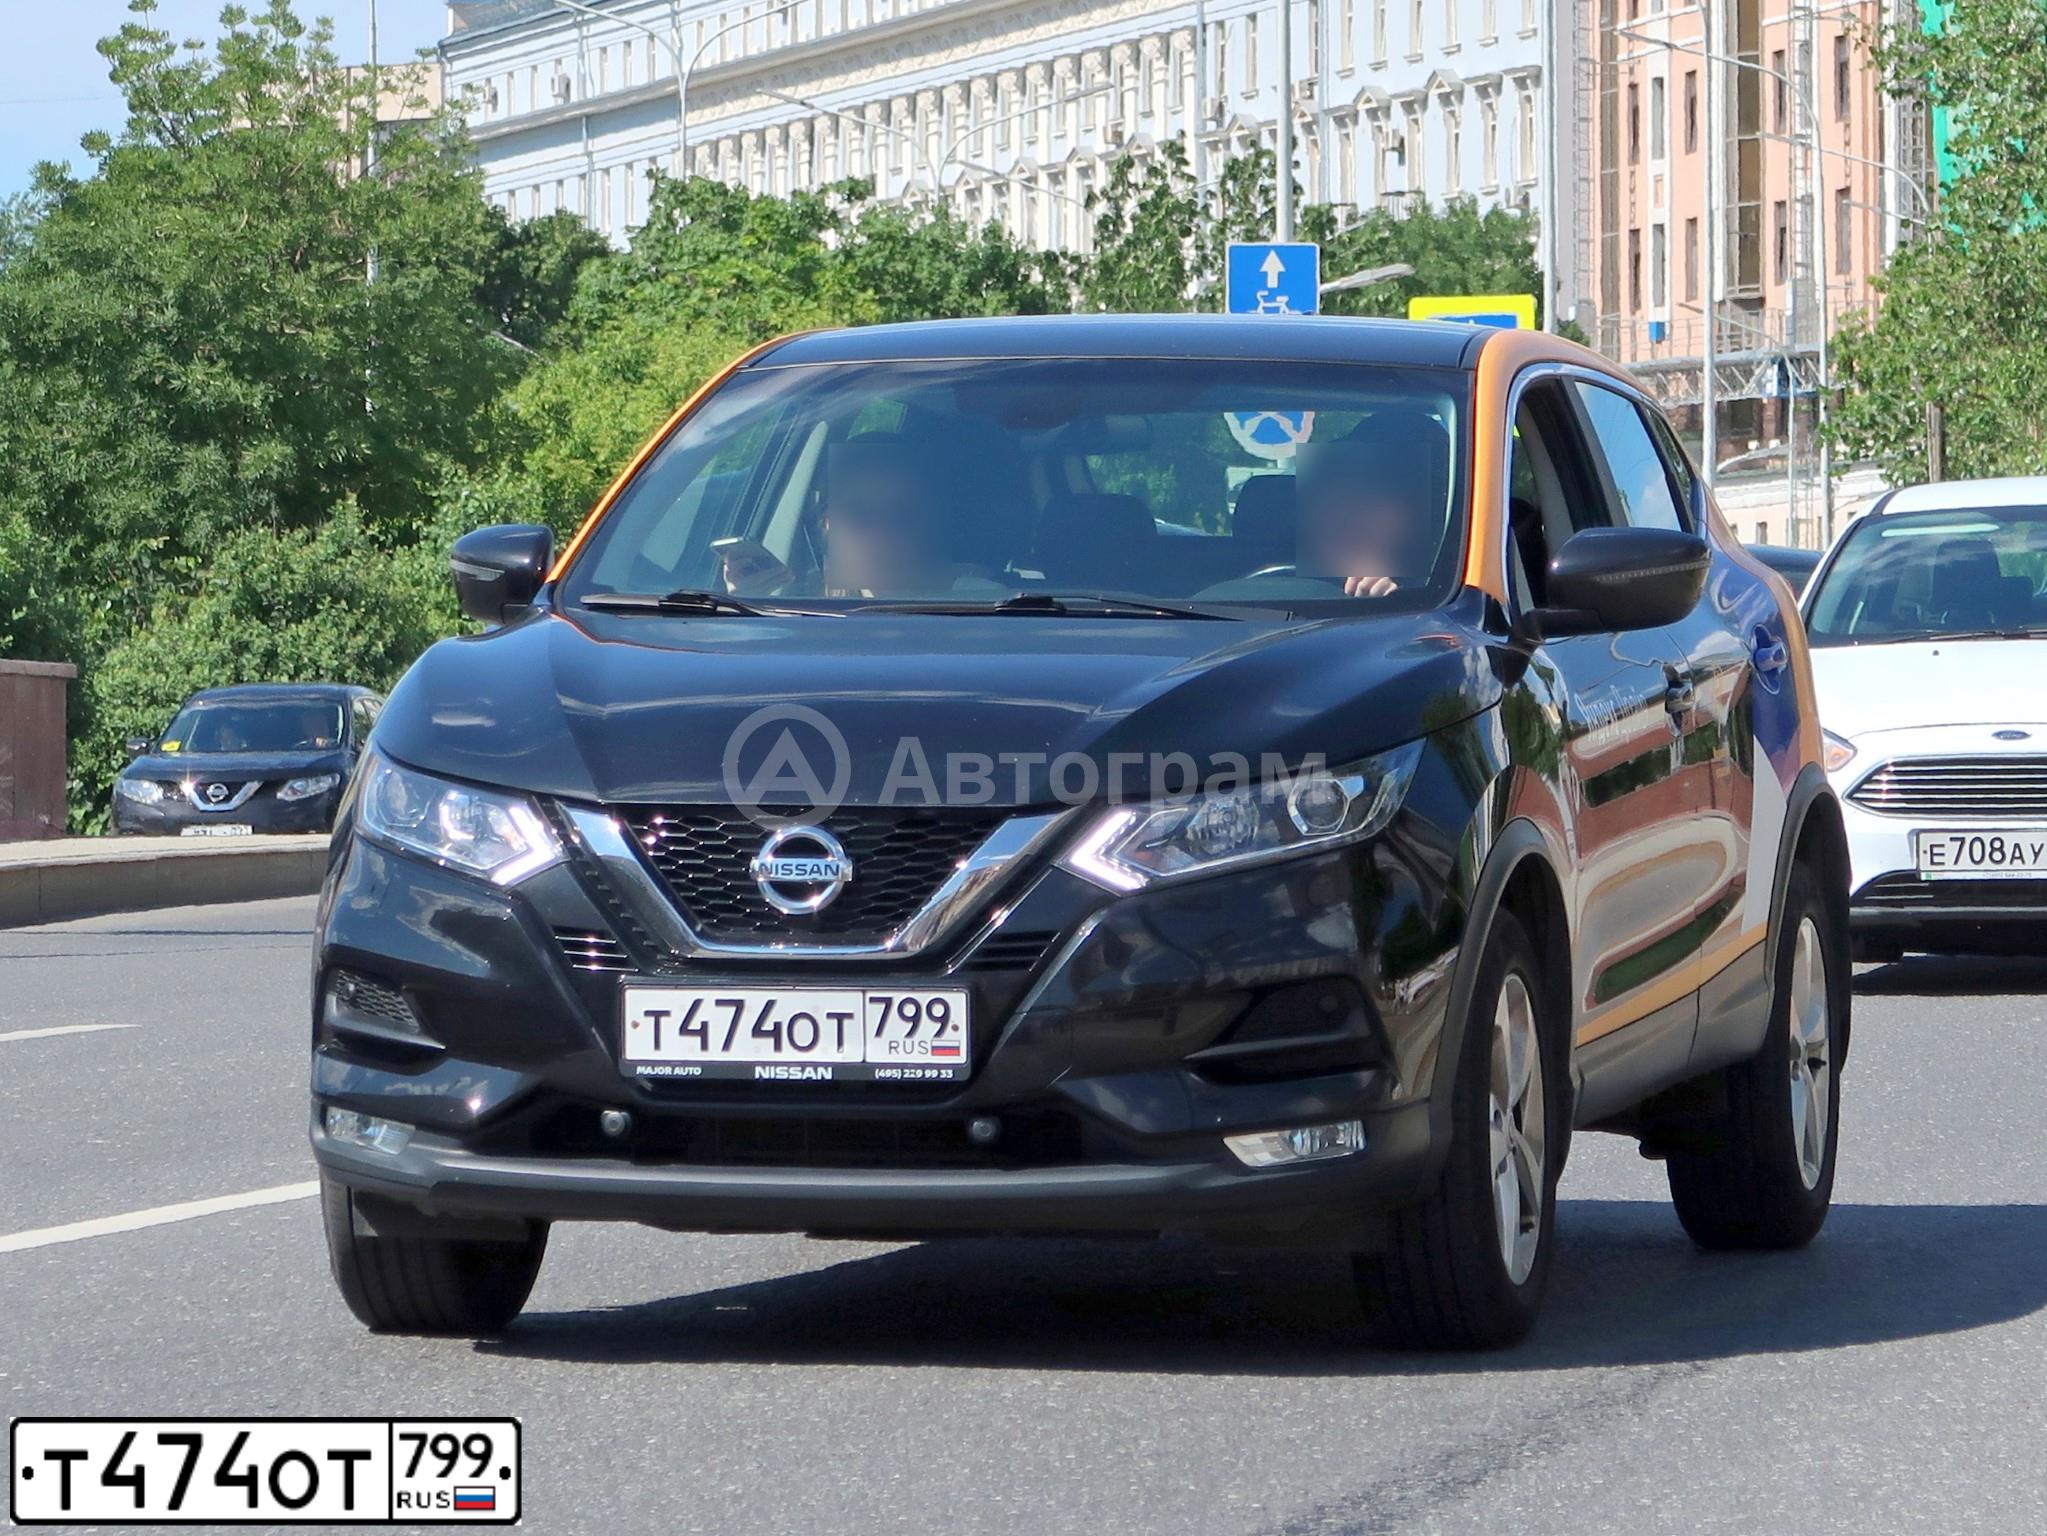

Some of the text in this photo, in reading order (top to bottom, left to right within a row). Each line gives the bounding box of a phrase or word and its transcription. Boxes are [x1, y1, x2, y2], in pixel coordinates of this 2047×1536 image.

[1929, 836, 2044, 866] Е708АУ
[759, 863, 840, 876] NISSAN
[869, 997, 950, 1038] 799
[644, 998, 854, 1053] Т474ОТ
[888, 1040, 929, 1055] RUS
[636, 1066, 702, 1076] MAJOR AUTO
[755, 1066, 832, 1080] NISSAN
[875, 1068, 902, 1079] (495)
